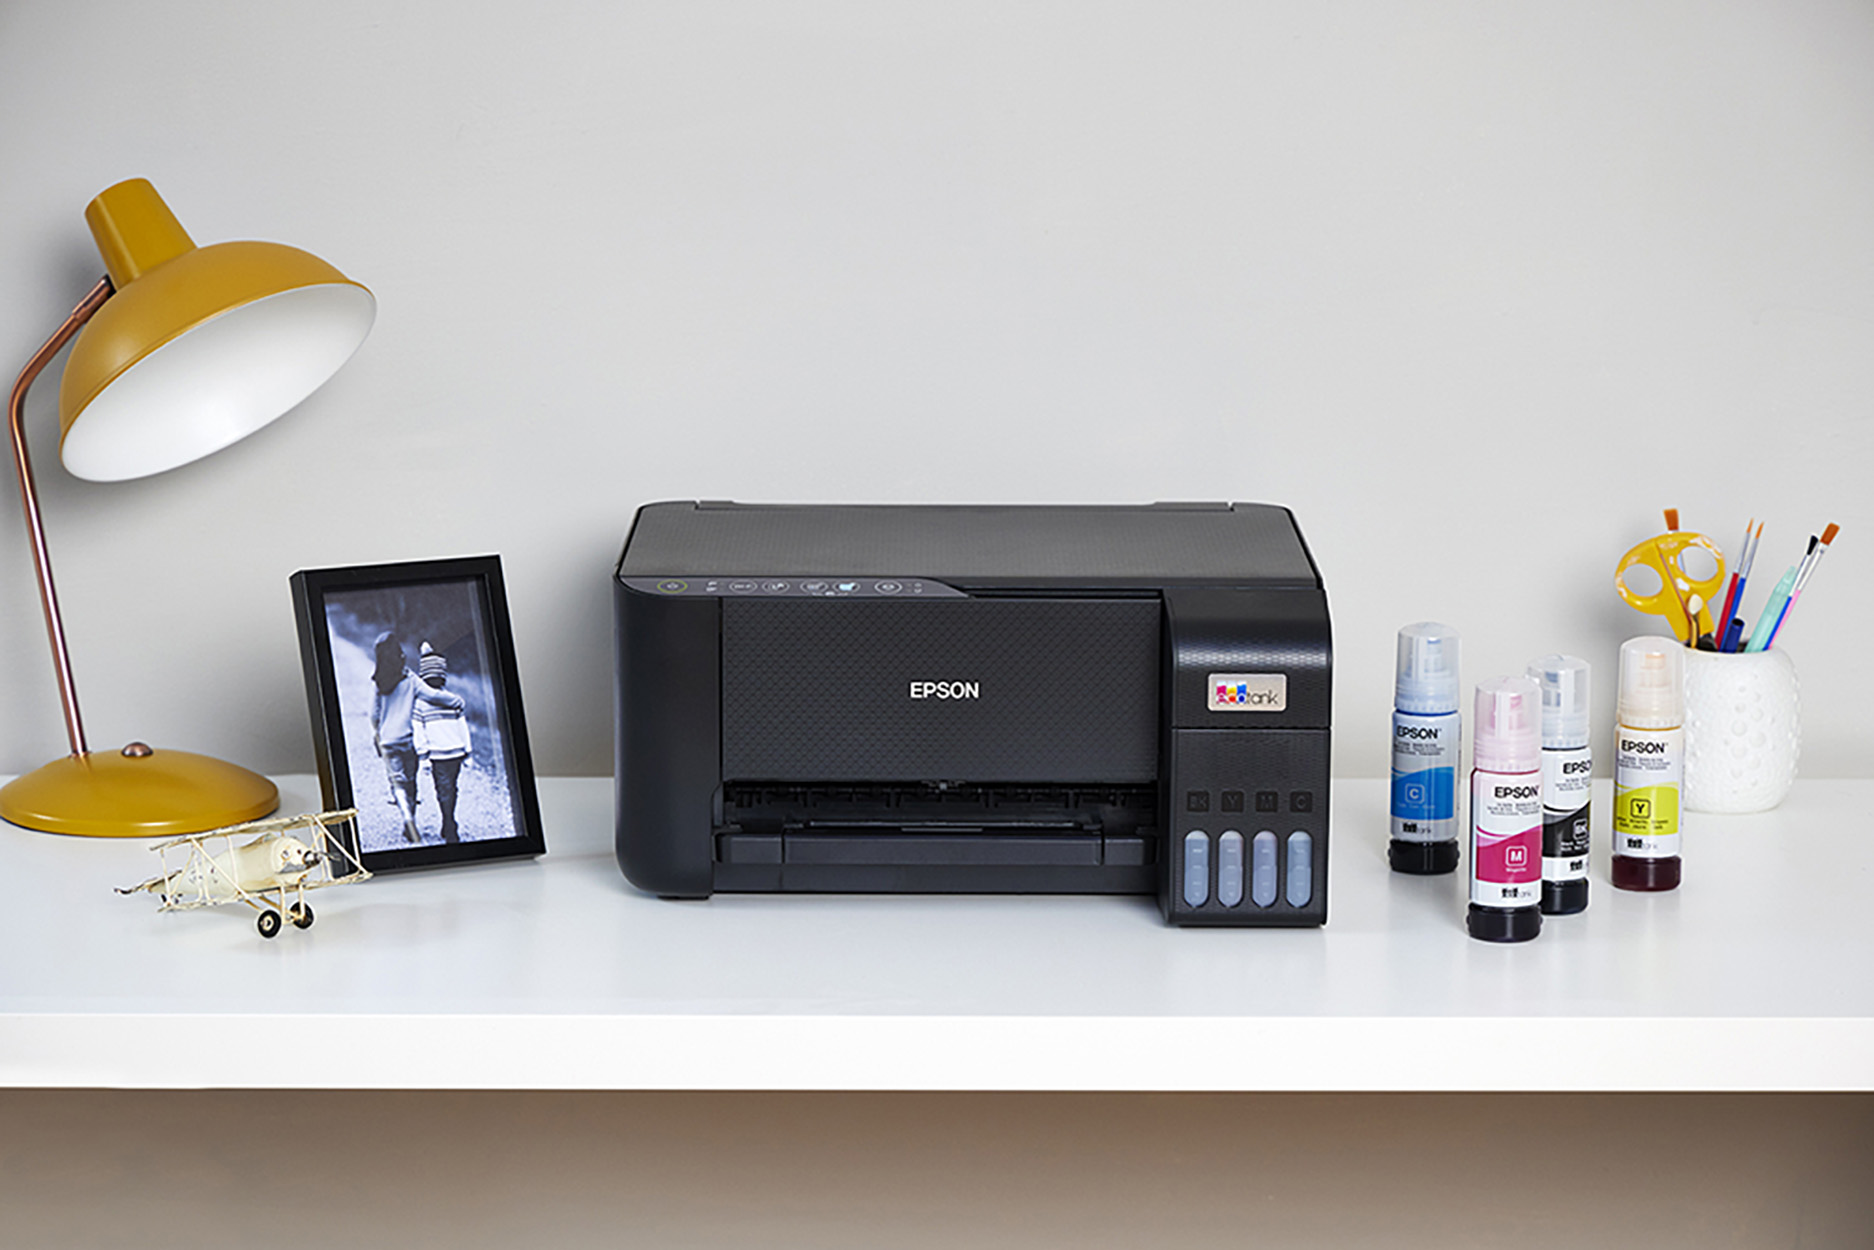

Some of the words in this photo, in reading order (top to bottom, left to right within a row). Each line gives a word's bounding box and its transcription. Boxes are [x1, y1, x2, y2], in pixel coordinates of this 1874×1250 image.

[911, 681, 979, 699] EPSON
[1396, 724, 1438, 739] EPSON
[1621, 740, 1664, 753] EPSON
[1409, 788, 1419, 799] C
[1494, 786, 1540, 799] EPSON
[1227, 795, 1239, 808] Y
[1260, 795, 1274, 808] M
[1296, 795, 1307, 809] C
[1635, 803, 1645, 813] Y
[1510, 850, 1522, 861] M
